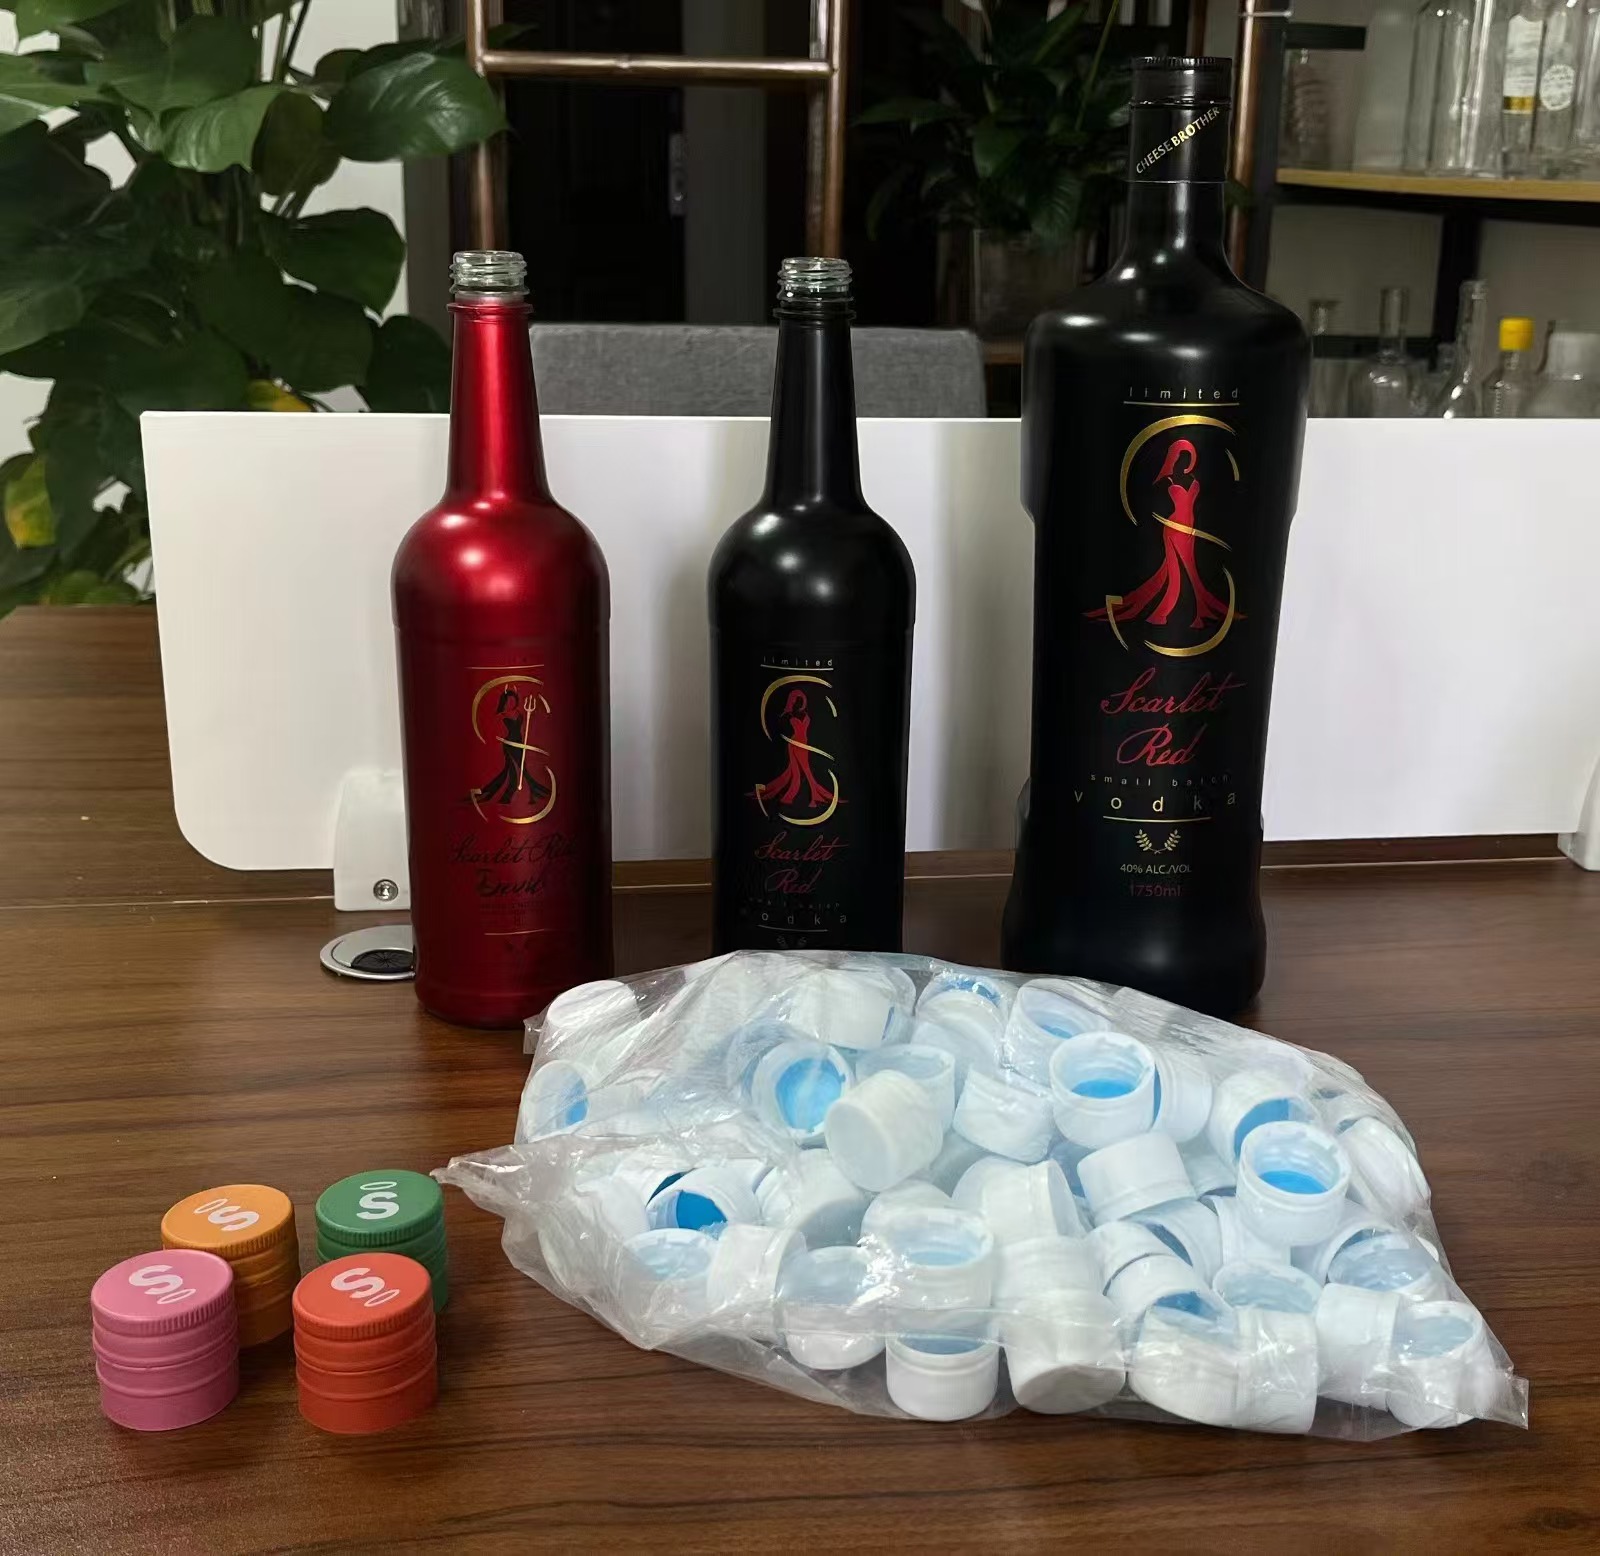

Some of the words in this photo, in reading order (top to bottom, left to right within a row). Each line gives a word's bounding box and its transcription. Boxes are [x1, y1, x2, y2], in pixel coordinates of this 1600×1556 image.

[1136, 140, 1173, 174] CHEESE
[1170, 106, 1220, 147] BROTHER
[1129, 387, 1239, 400] limited
[763, 655, 833, 667] limited
[1100, 667, 1247, 714] Scarlet
[1116, 723, 1208, 767] Red
[1090, 773, 1152, 787] small
[1074, 789, 1237, 813] vodka
[754, 830, 849, 861] Scarlet
[764, 866, 824, 894] Red
[1119, 863, 1143, 874] 40%
[1129, 880, 1182, 897] 1750ml
